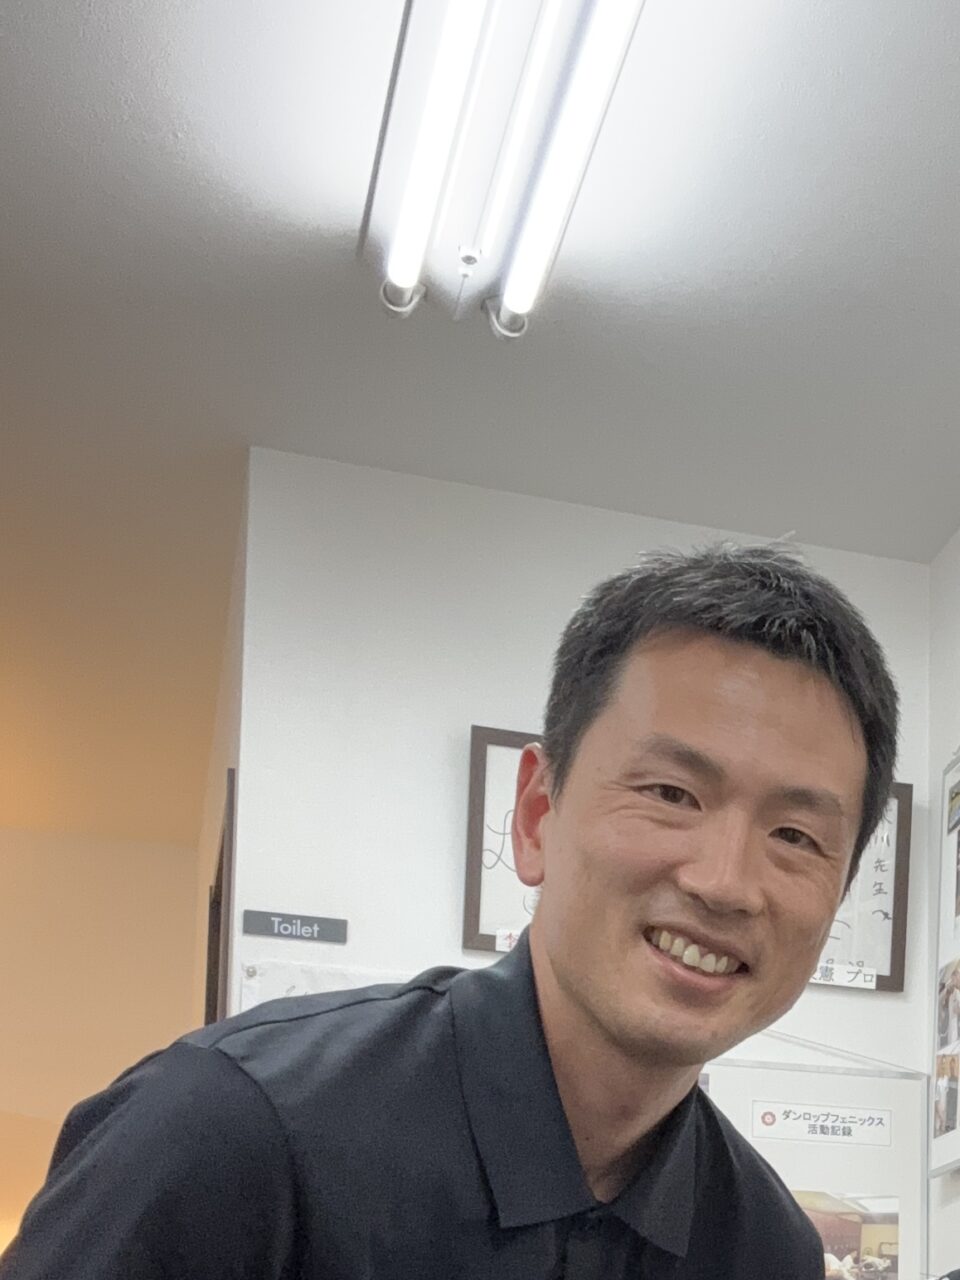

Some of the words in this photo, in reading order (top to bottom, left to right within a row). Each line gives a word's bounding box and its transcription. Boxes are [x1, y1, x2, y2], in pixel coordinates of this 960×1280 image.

[270, 916, 320, 938] Toilet
[782, 1109, 885, 1127] ダンロップフェニックス
[807, 1124, 853, 1137] 活動記録
